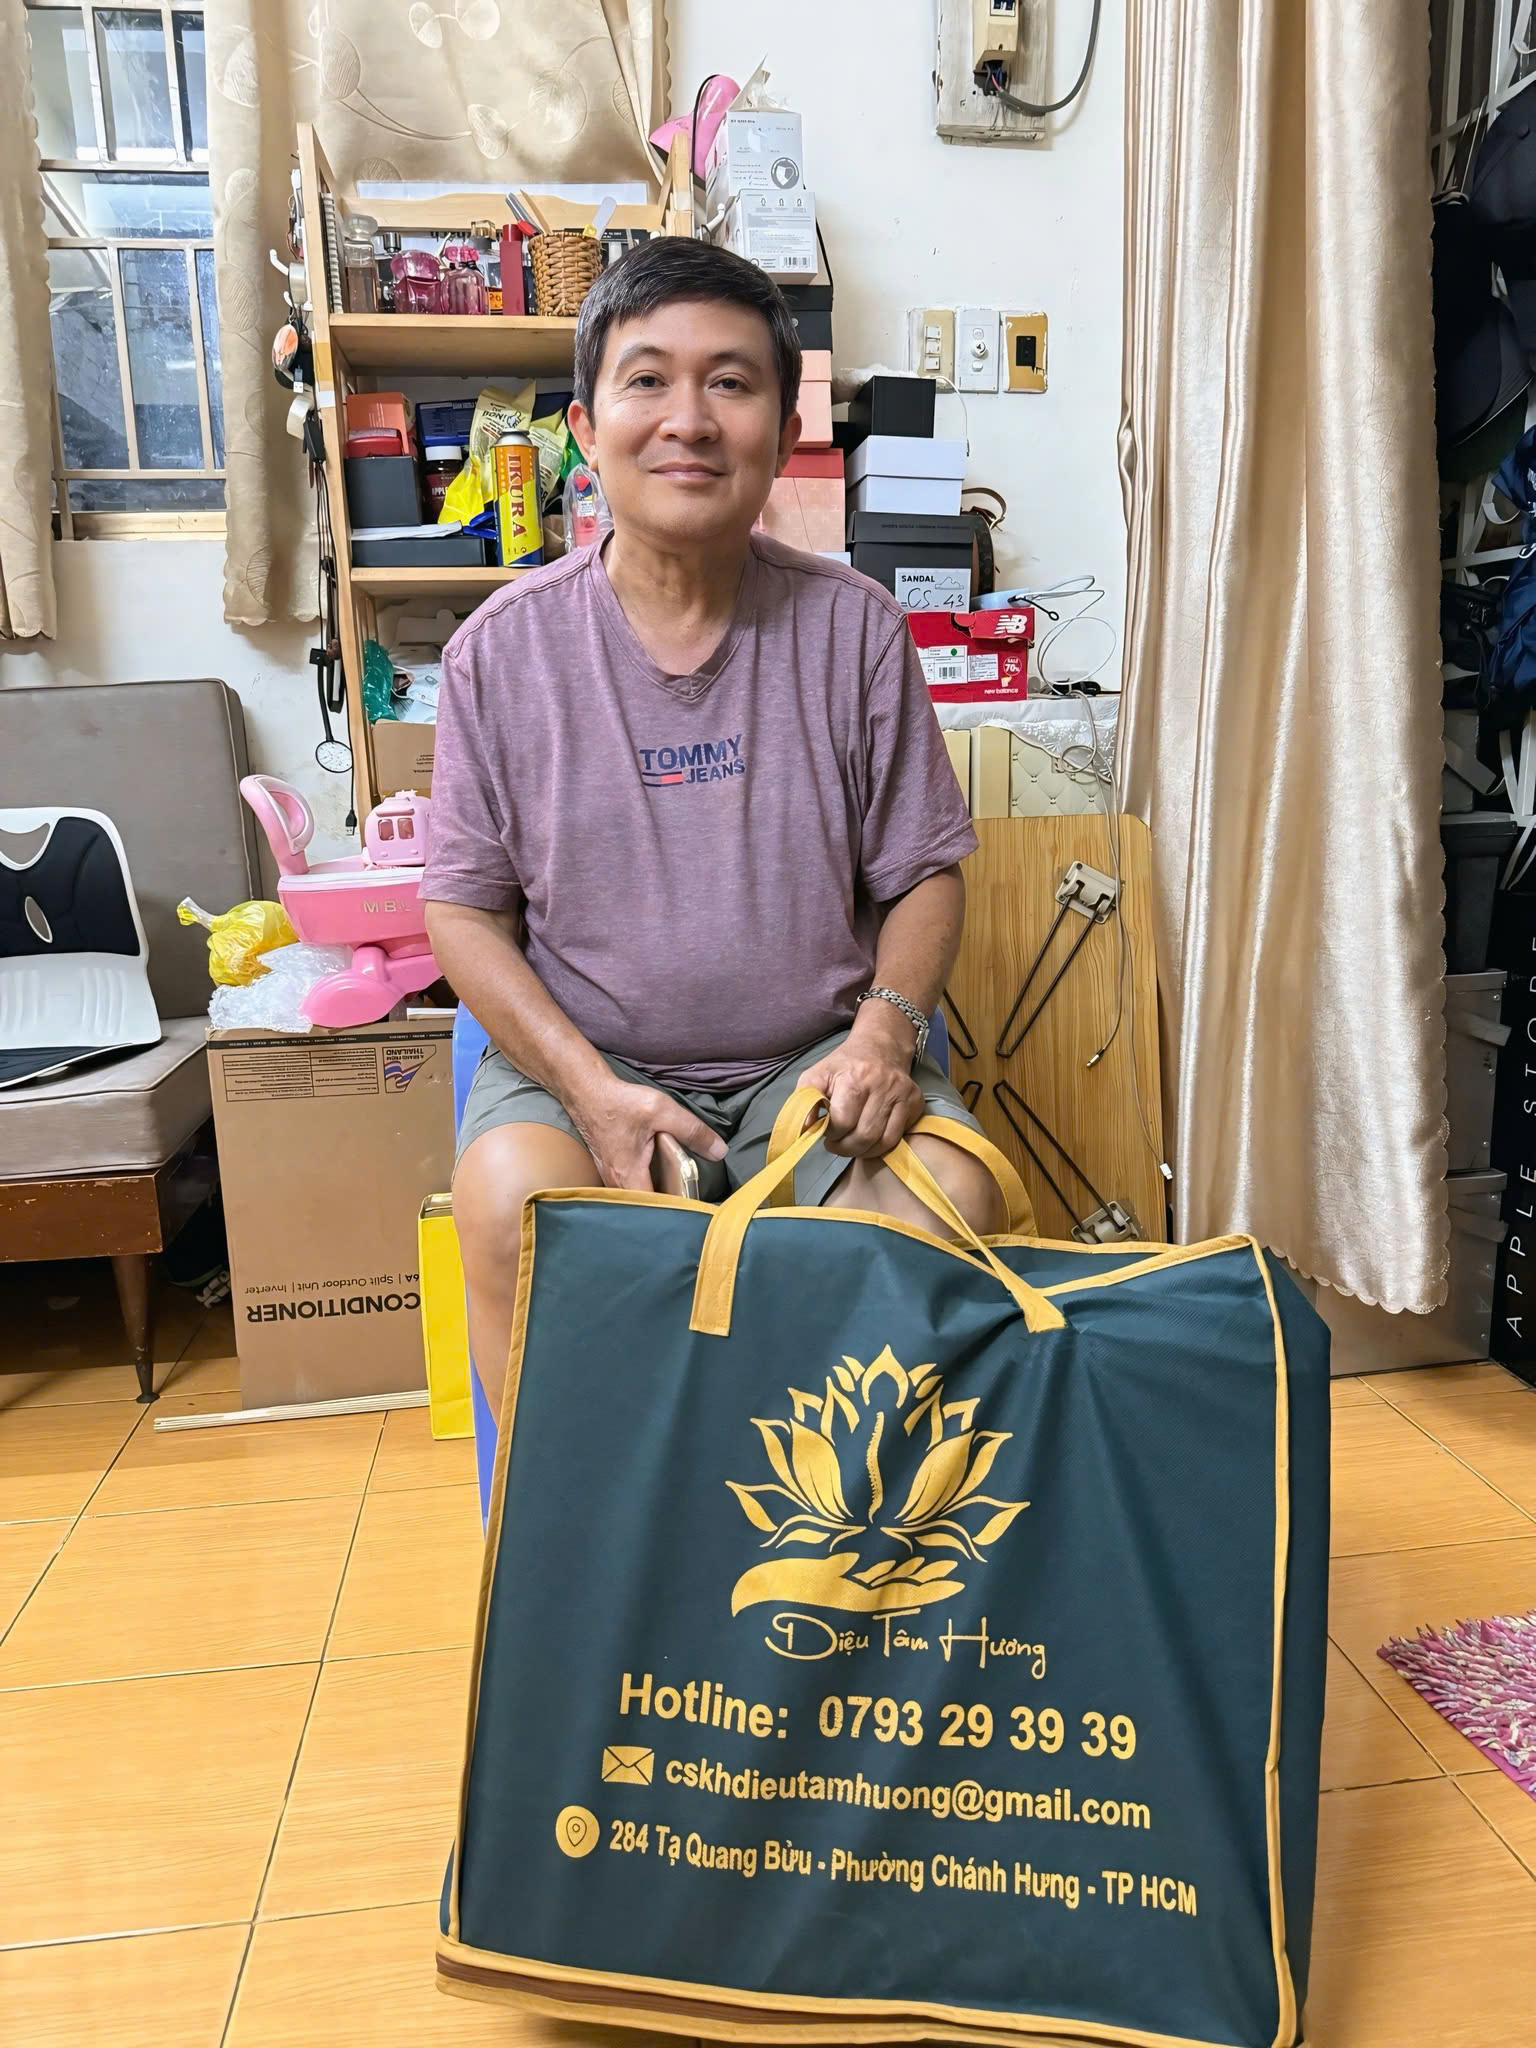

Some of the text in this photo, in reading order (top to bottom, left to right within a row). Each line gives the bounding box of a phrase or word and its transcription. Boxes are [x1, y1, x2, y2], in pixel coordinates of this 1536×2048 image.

[508, 453, 528, 539] IKURA
[901, 575, 936, 583] SANDAL
[943, 593, 965, 609] 43
[1005, 663, 1020, 673] 70%
[639, 733, 742, 770] TOMMY
[685, 757, 746, 784] JEANS
[1506, 1163, 1536, 1338] APPLE
[245, 1284, 287, 1295] Inverter
[297, 1282, 320, 1292] Unit
[322, 1278, 367, 1289] Outdoor
[370, 1274, 394, 1286] Split
[246, 1292, 421, 1323] CONDITIONER
[764, 1607, 1046, 1680] Diệu Tâm Hương
[619, 1672, 1137, 1760] Hotline: 0793 29 39 39
[665, 1757, 1151, 1829] cskhdieutamhuong@gmail.com
[609, 1820, 649, 1853] 284
[655, 1824, 680, 1866] Tạ
[686, 1832, 757, 1878] Quang
[764, 1839, 812, 1875] Bửu
[830, 1848, 924, 1893] Phường
[931, 1854, 1007, 1893] Chánh
[1014, 1861, 1080, 1909] Hưng
[1101, 1870, 1134, 1905] TP
[1140, 1874, 1197, 1917] HCM
